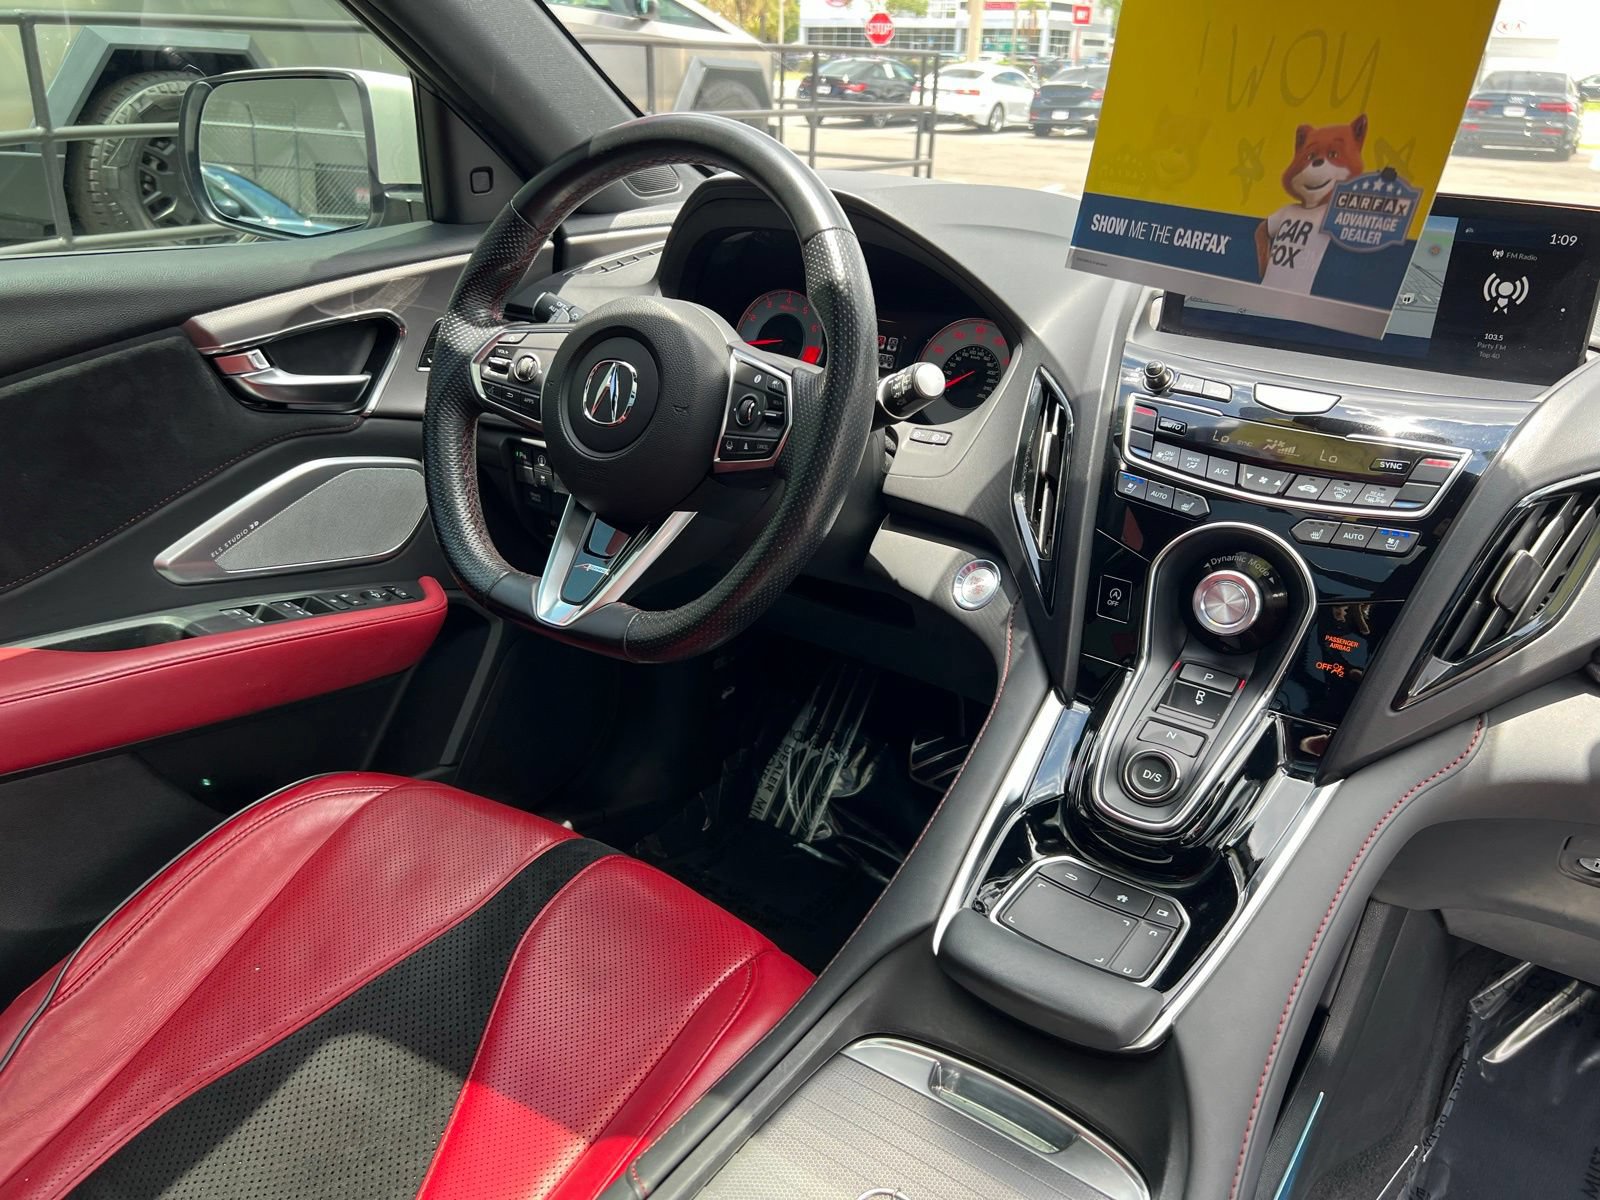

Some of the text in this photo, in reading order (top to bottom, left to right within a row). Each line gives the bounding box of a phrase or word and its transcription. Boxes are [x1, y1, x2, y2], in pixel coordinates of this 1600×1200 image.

[865, 23, 894, 35] STOP
[1337, 193, 1408, 216] CARFAX
[1334, 212, 1400, 232] ADVANTAGE
[1091, 213, 1230, 255] SHOW ME THE CARFAX
[1276, 218, 1314, 246] CAR
[1339, 227, 1382, 245] DEALER
[1549, 233, 1578, 247] 1:09
[1519, 253, 1538, 261] Radio
[1484, 333, 1504, 341] 103.5
[1477, 341, 1493, 350] Party
[1479, 351, 1491, 359] Top
[1212, 430, 1230, 443] Lo
[1319, 449, 1338, 463] Lo
[1214, 467, 1229, 475] A/C
[1379, 461, 1403, 470] SYNC
[1150, 490, 1168, 500] AUTO
[1333, 486, 1352, 494] FRONT
[211, 521, 259, 557] ELS STUDIO 3D
[1343, 532, 1364, 541] AUTO
[1210, 554, 1270, 577] Dynamic Mode
[1324, 634, 1360, 648] PASSENGER
[1329, 642, 1351, 652] AIRBAG
[1315, 661, 1332, 671] OFF
[1203, 672, 1214, 681] P
[1195, 690, 1206, 701] R
[1166, 730, 1177, 740] N
[1142, 769, 1162, 783] D/S
